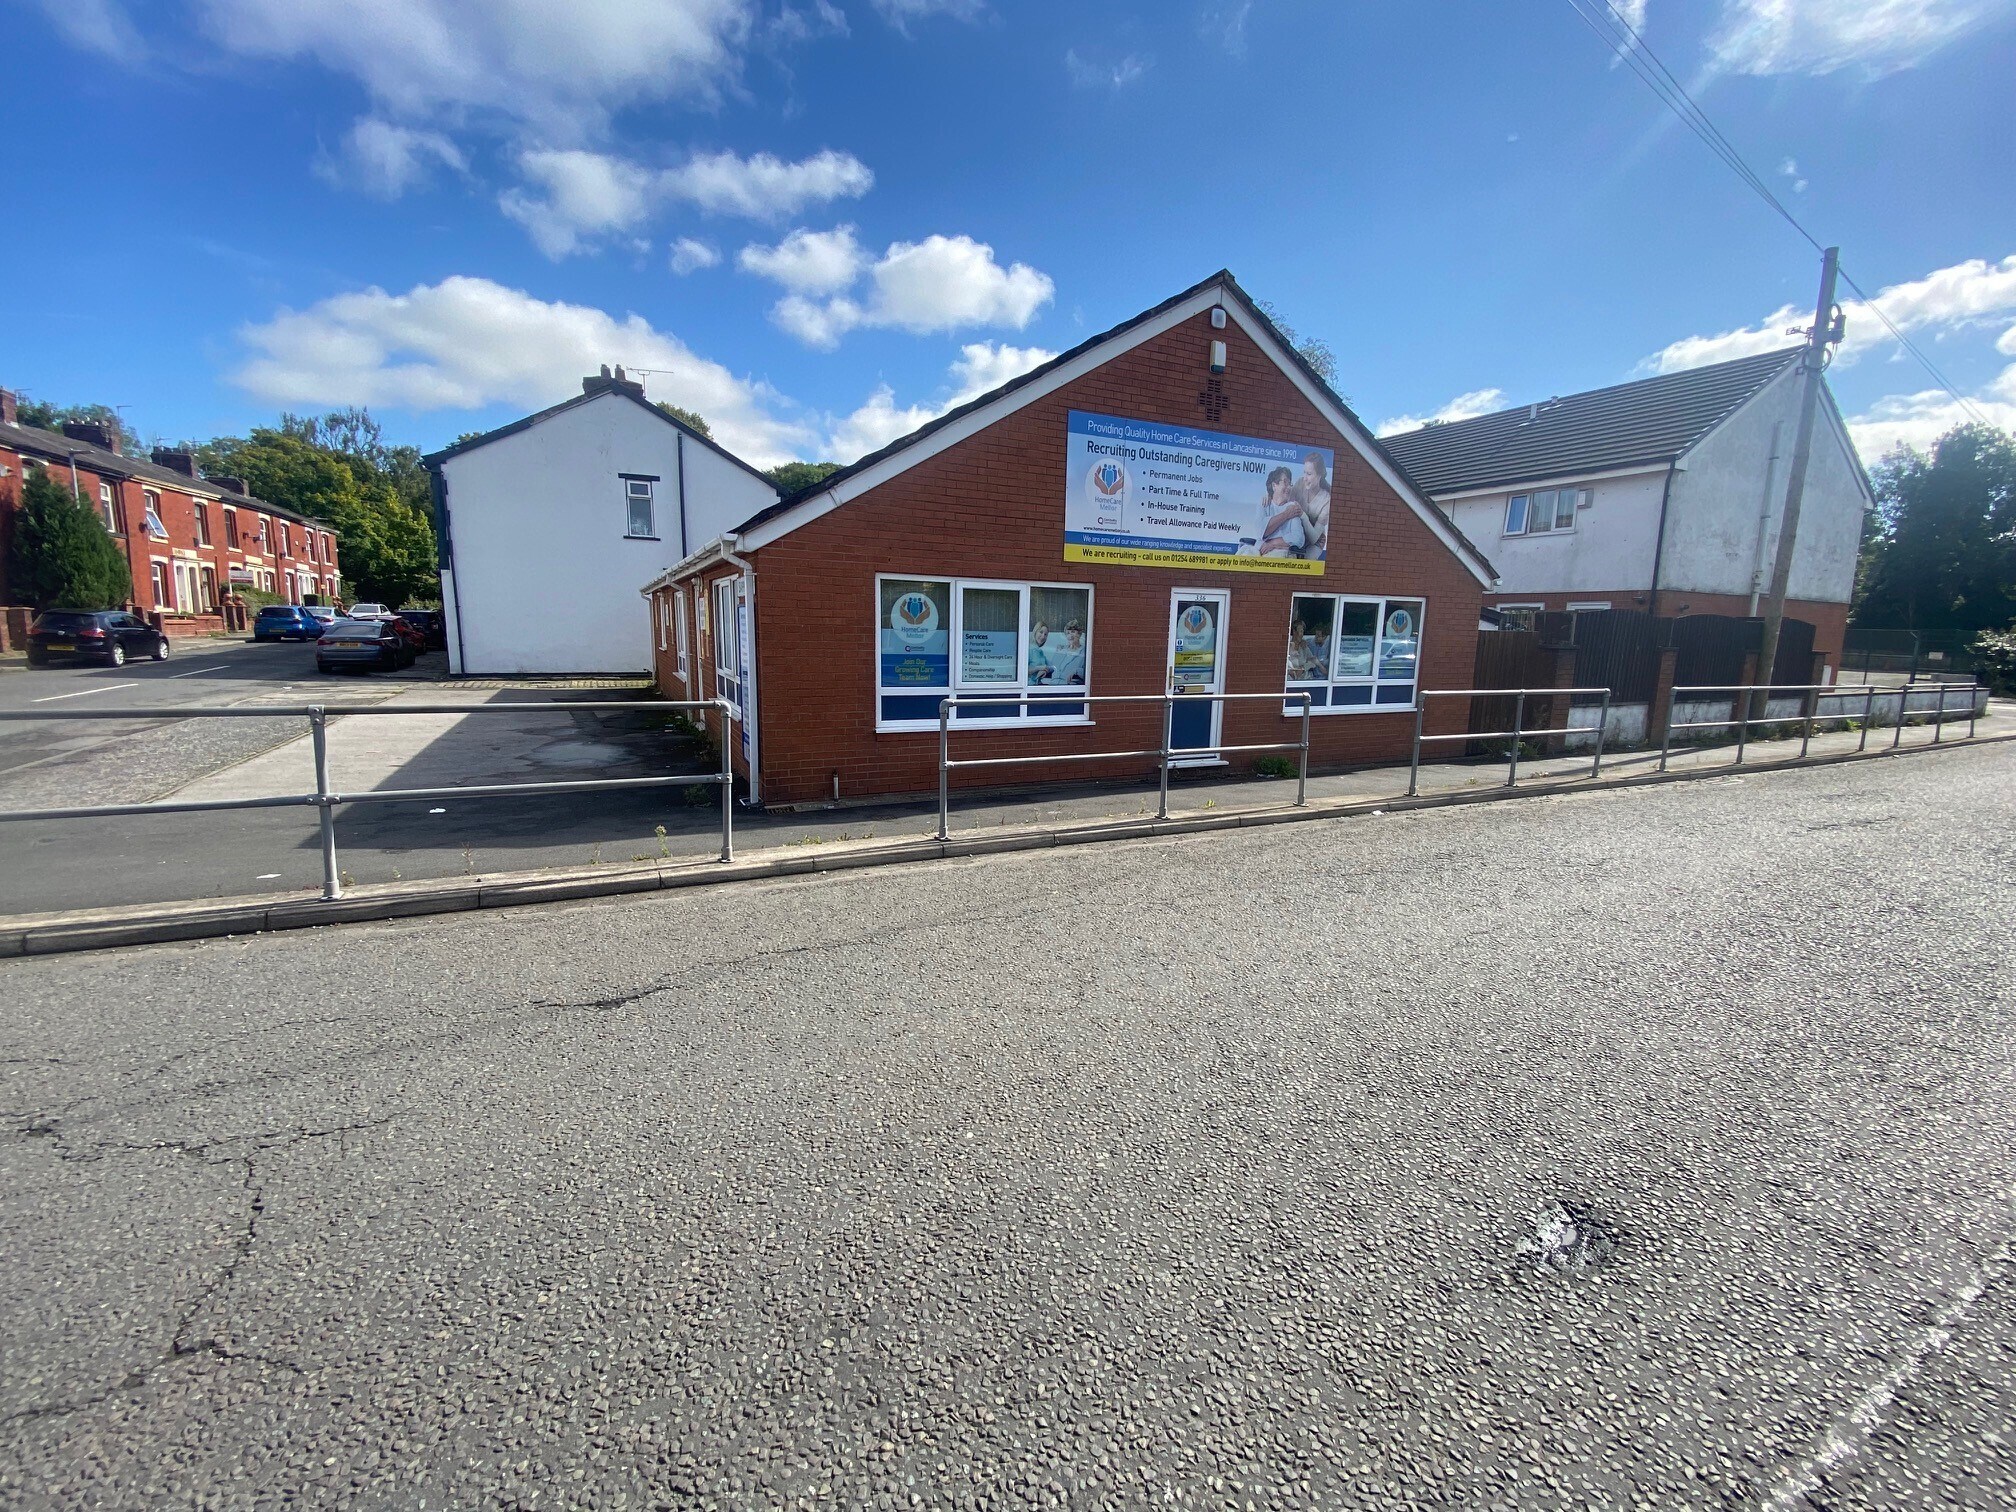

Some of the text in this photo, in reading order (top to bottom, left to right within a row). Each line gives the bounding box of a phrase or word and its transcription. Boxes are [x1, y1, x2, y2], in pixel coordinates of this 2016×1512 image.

[1087, 420, 1297, 459] Providing Quality Home Care Services in Lancashire since 1990
[1087, 441, 1266, 474] Recruiting Outstanding Caregivers NOW!
[1150, 470, 1203, 483] Permanent Jobs
[1149, 485, 1220, 500] Part Time & Full Time
[1095, 497, 1121, 505] HomeCare
[1148, 501, 1205, 515] In-House Training
[1147, 516, 1241, 533] Travel Allowance Paid Weekly
[1142, 540, 1159, 548] ranging
[1160, 541, 1183, 550] knowledge
[1193, 543, 1212, 551] specialist
[1083, 549, 1092, 557] We
[1107, 550, 1136, 561] recruiting
[1171, 554, 1188, 563] 01254
[1217, 558, 1232, 566] apply
[1239, 559, 1311, 570] info@homecaremellor.co.uk
